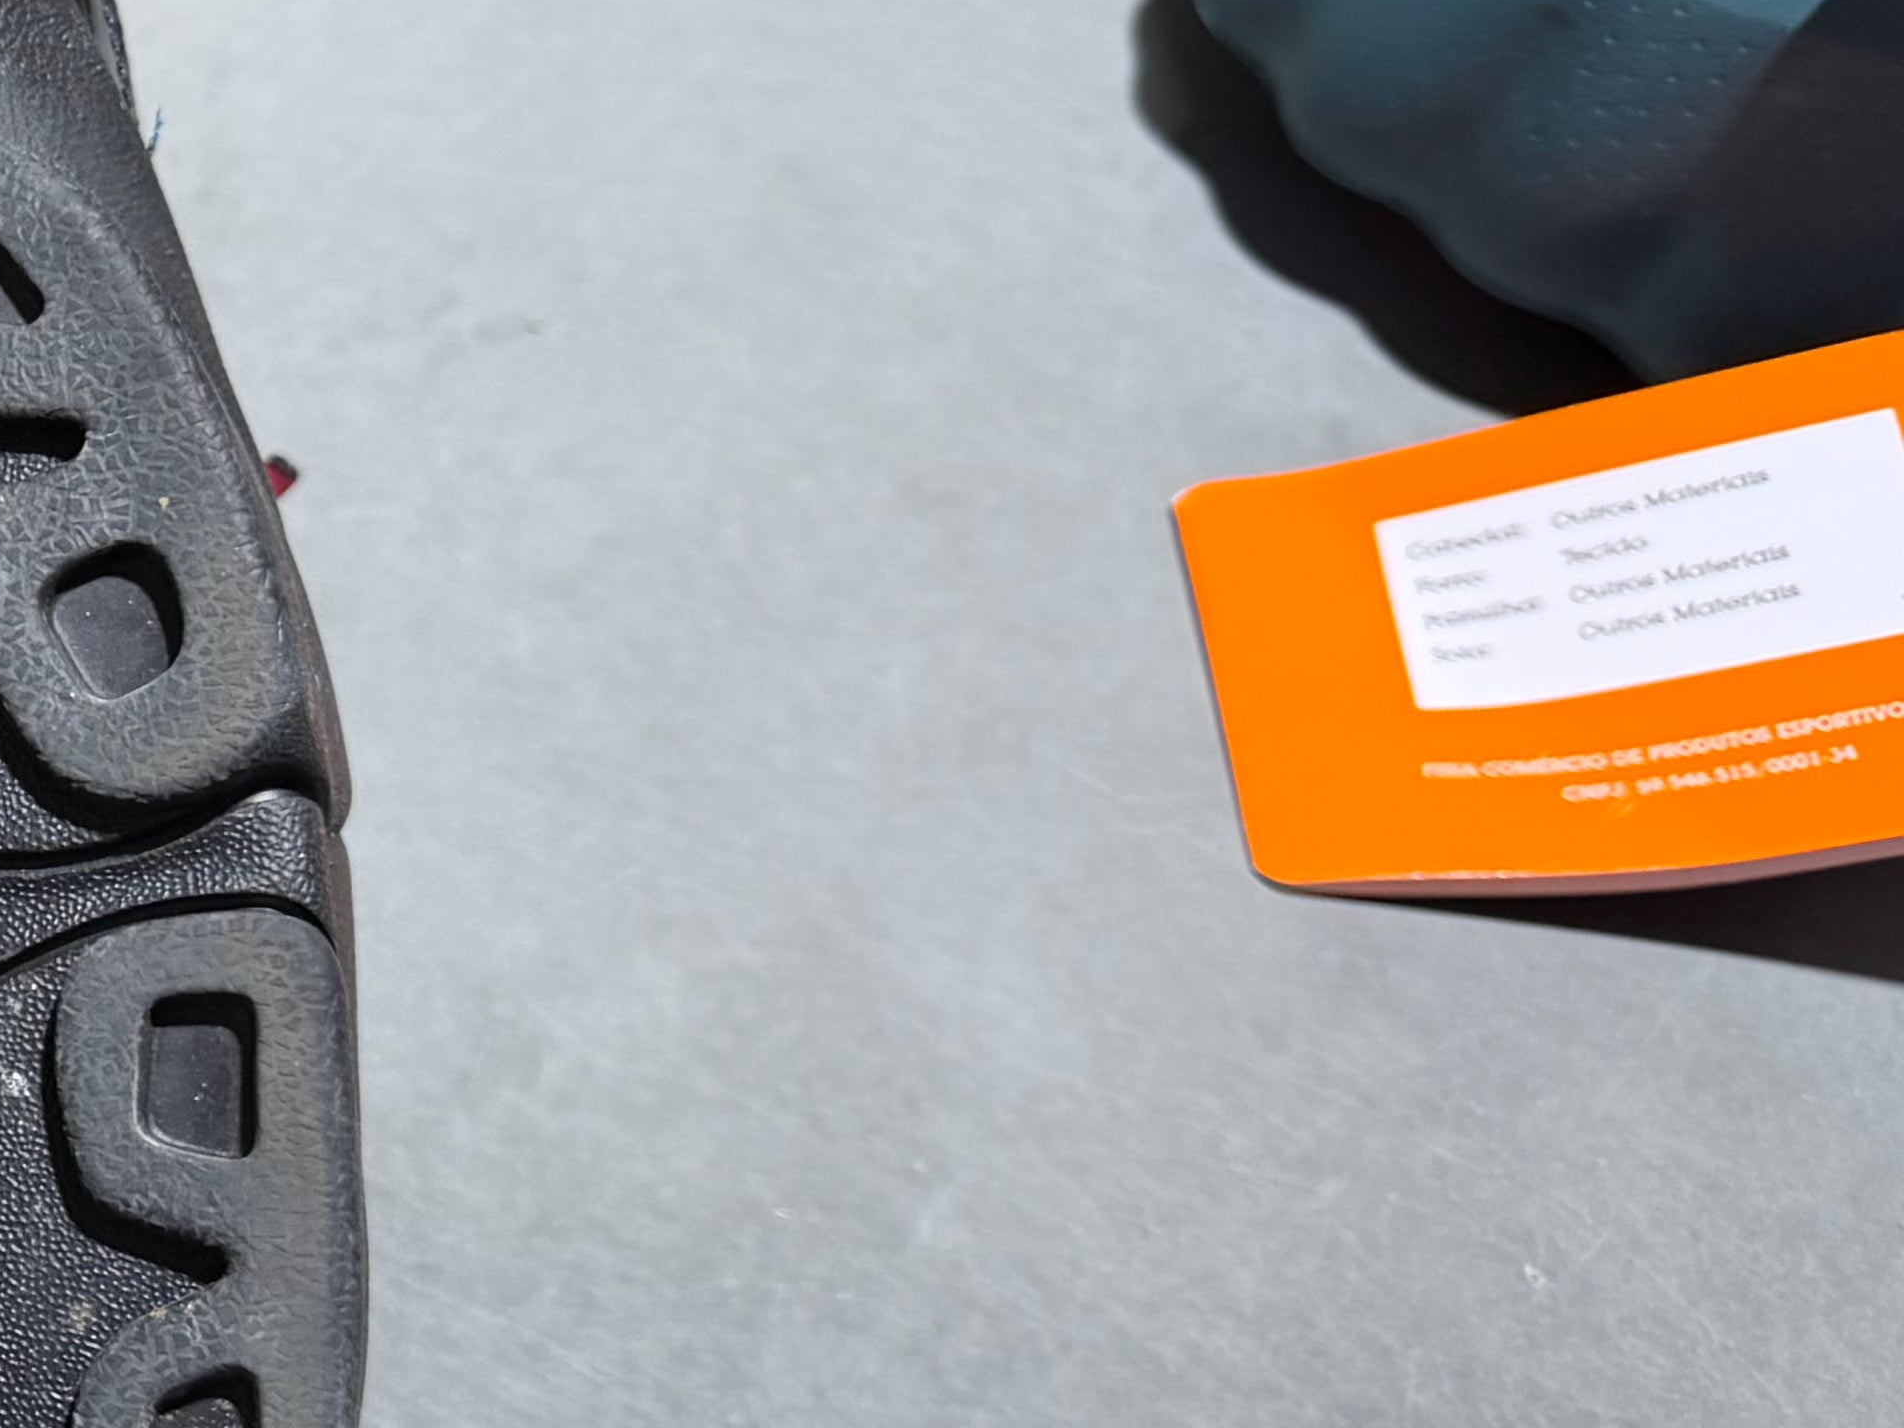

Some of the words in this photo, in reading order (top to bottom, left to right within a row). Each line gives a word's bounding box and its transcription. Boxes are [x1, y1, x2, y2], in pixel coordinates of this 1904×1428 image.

[1551, 500, 1637, 530] Outros
[1643, 469, 1770, 508] Materiais
[1568, 573, 1657, 604] Outros
[1661, 544, 1790, 583] Materiais
[1578, 612, 1666, 641] Outros
[1672, 582, 1801, 621] Materiais
[1611, 747, 1645, 767] DE
[1648, 725, 1773, 762] PRODUTOS
